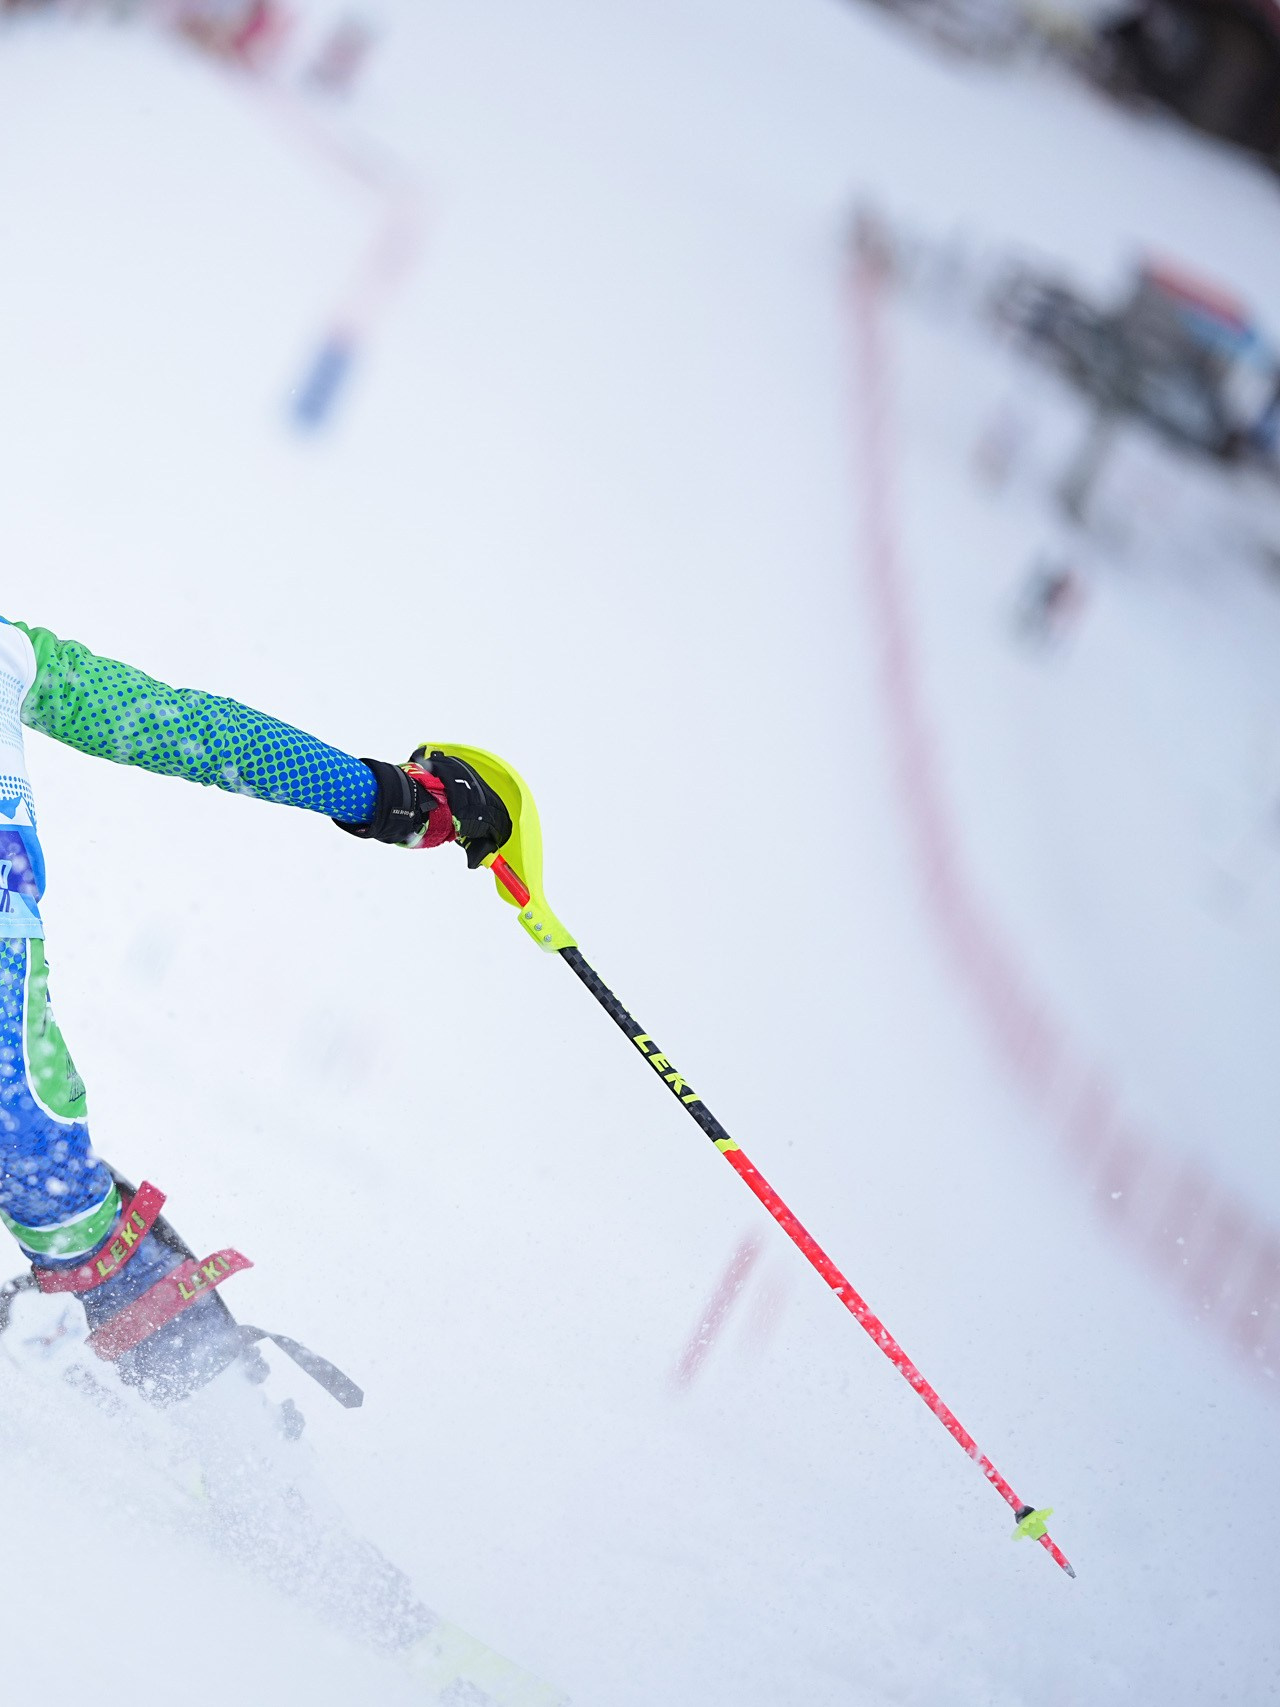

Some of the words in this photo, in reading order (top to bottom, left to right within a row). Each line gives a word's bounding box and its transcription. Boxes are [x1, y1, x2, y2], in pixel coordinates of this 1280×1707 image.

[632, 1033, 702, 1105] LEKI
[95, 1210, 146, 1277] LEKI
[177, 1256, 231, 1300] LEKI
